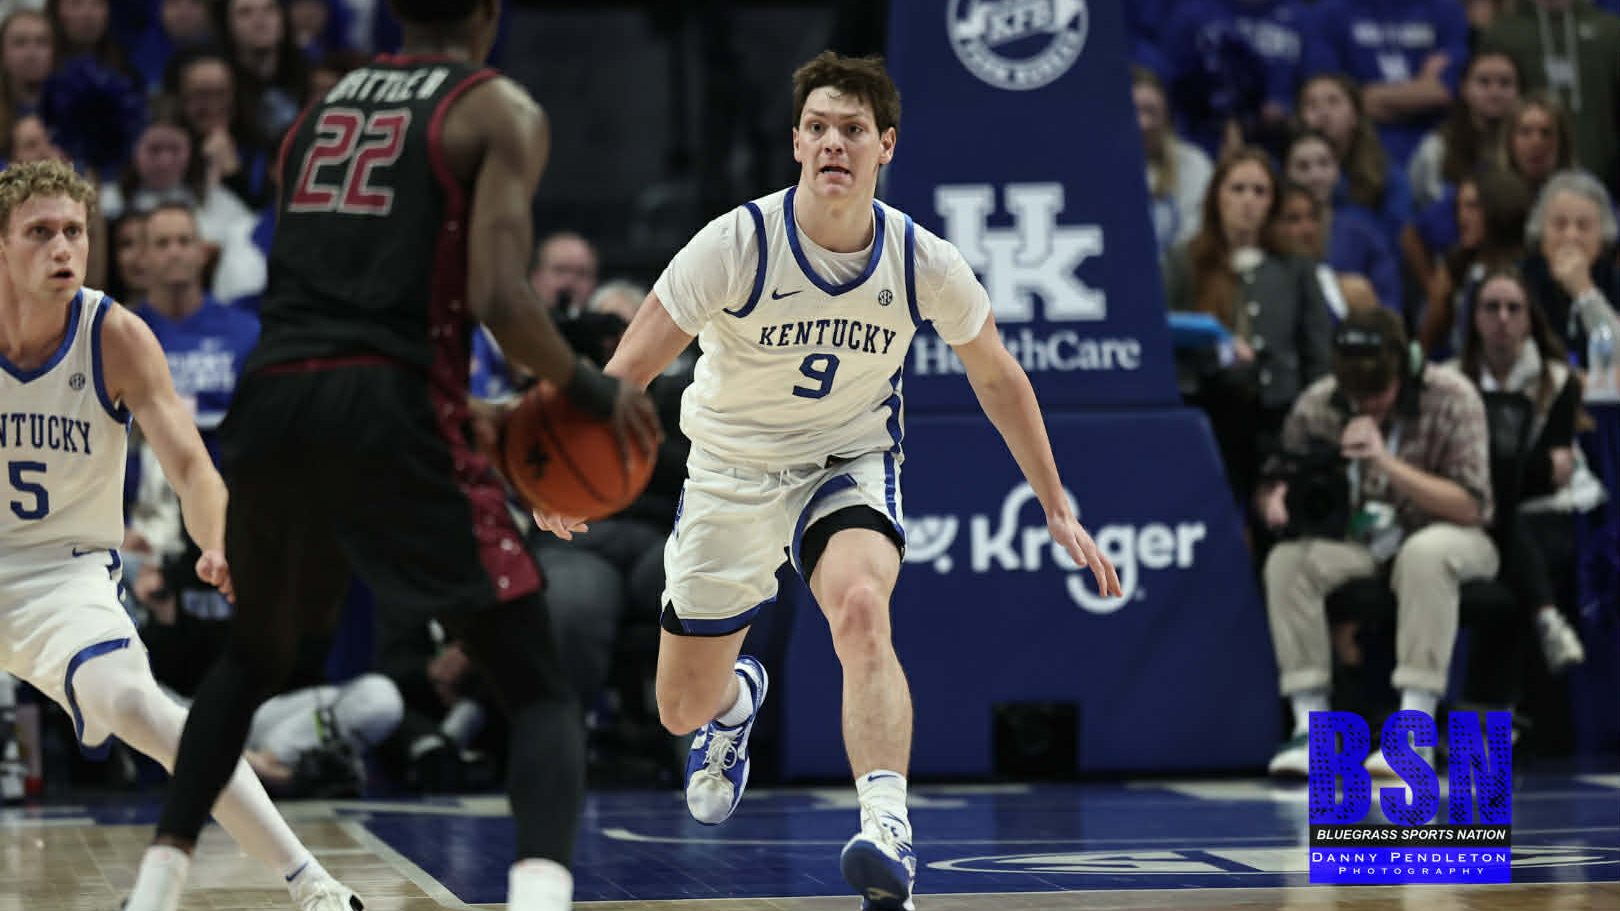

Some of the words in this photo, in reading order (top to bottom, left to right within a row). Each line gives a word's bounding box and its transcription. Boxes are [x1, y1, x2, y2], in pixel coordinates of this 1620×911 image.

[287, 106, 413, 216] 22
[934, 182, 1107, 322] UK
[759, 318, 897, 354] KENTUCKY
[913, 329, 1143, 376] HthCare
[792, 353, 841, 399] 9
[8, 460, 50, 520] 5
